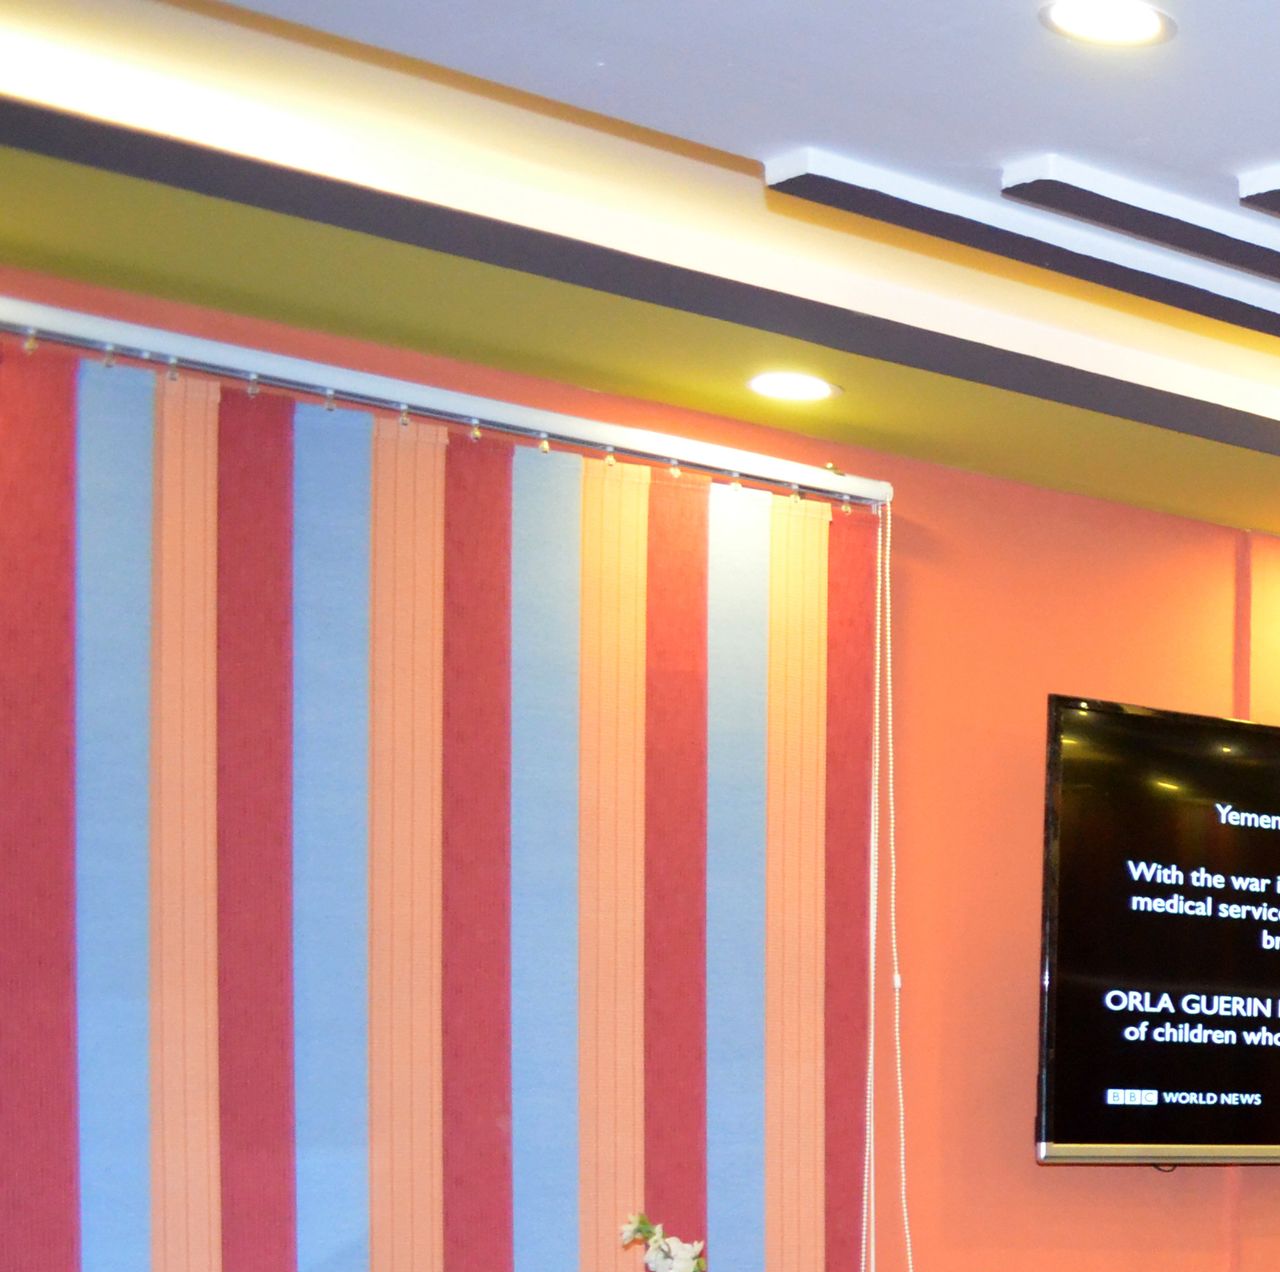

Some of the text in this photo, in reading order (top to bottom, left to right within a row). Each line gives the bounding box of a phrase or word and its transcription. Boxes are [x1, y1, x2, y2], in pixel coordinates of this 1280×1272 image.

[1127, 859, 1185, 886] With
[1189, 866, 1226, 889] the
[1230, 875, 1272, 893] war
[1131, 893, 1213, 917] medical
[1104, 989, 1176, 1014] ORLA
[1180, 993, 1272, 1018] GUERIN
[1123, 1020, 1150, 1041] of
[1152, 1021, 1237, 1045] children
[1106, 1088, 1262, 1106] BBC WORLD NEWS
